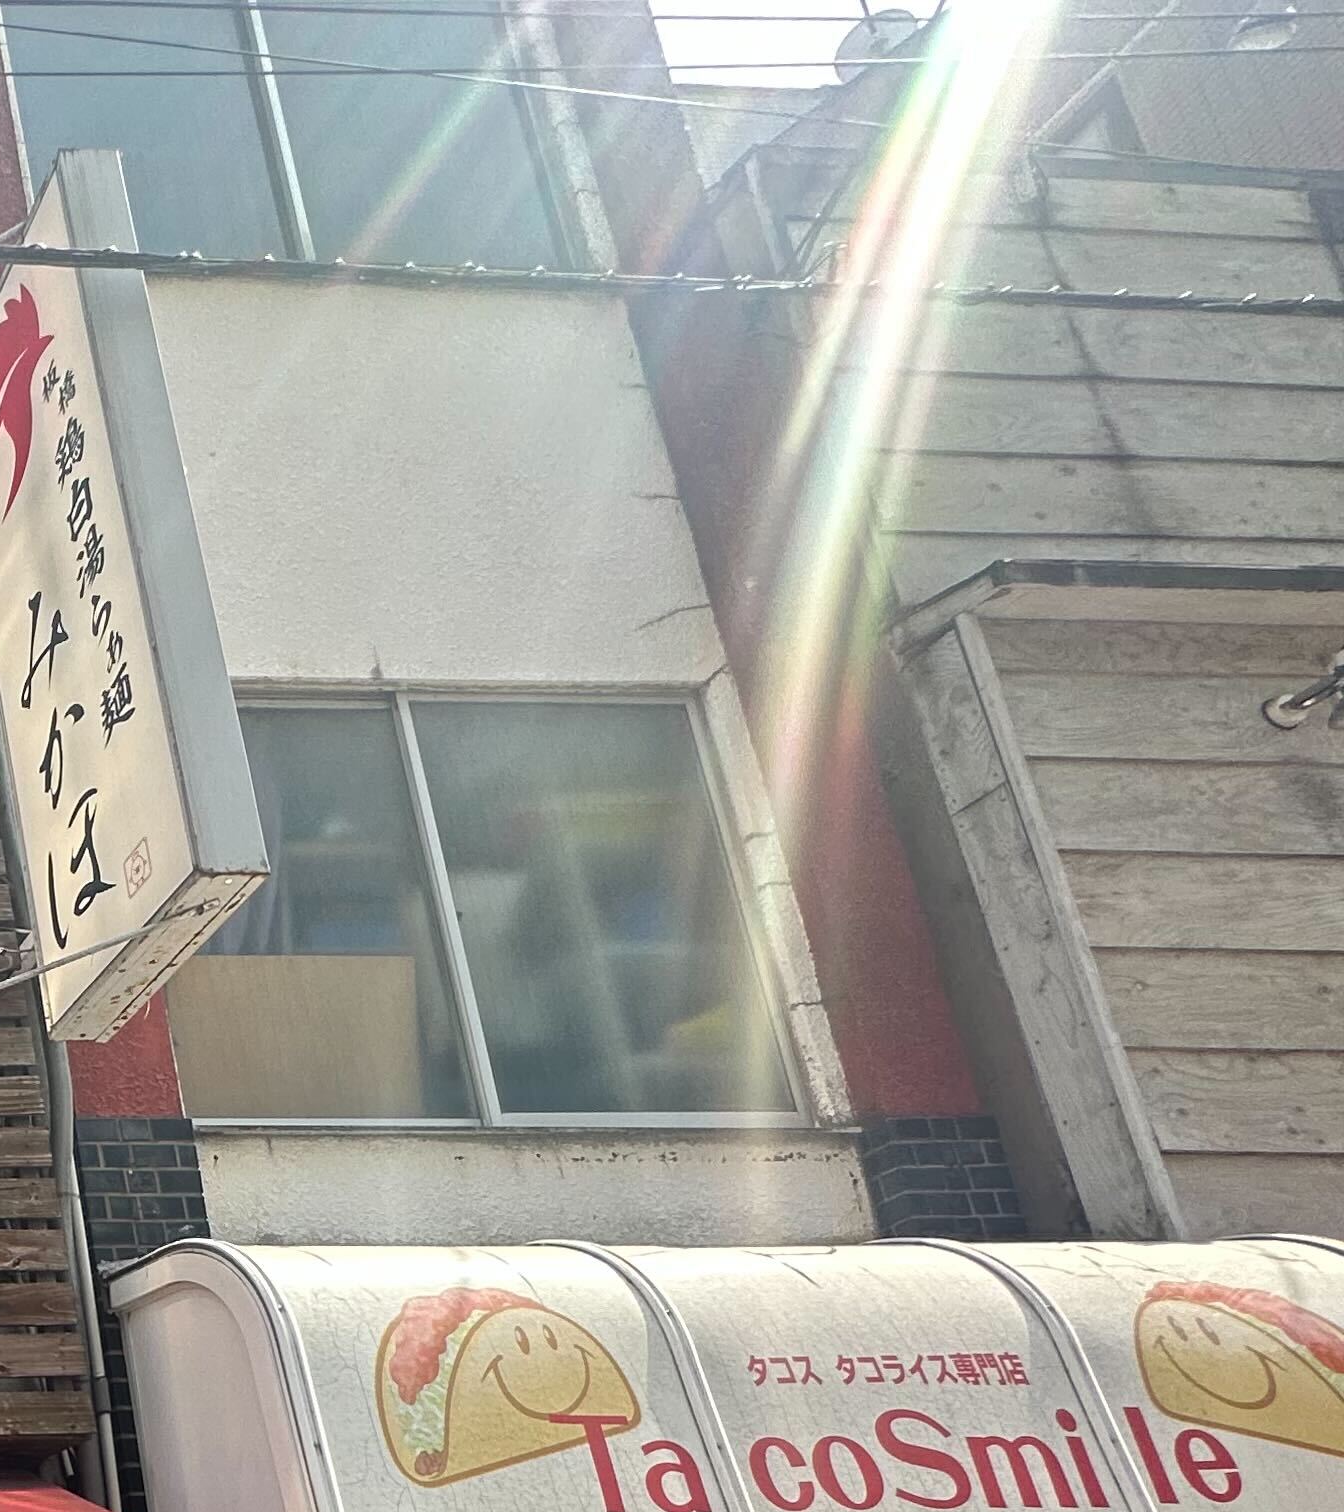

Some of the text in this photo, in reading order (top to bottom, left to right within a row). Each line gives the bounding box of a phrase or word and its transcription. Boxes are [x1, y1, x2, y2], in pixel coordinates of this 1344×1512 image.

[22, 591, 116, 949] みかほ
[746, 1352, 1030, 1387] タコス タコライス専門店
